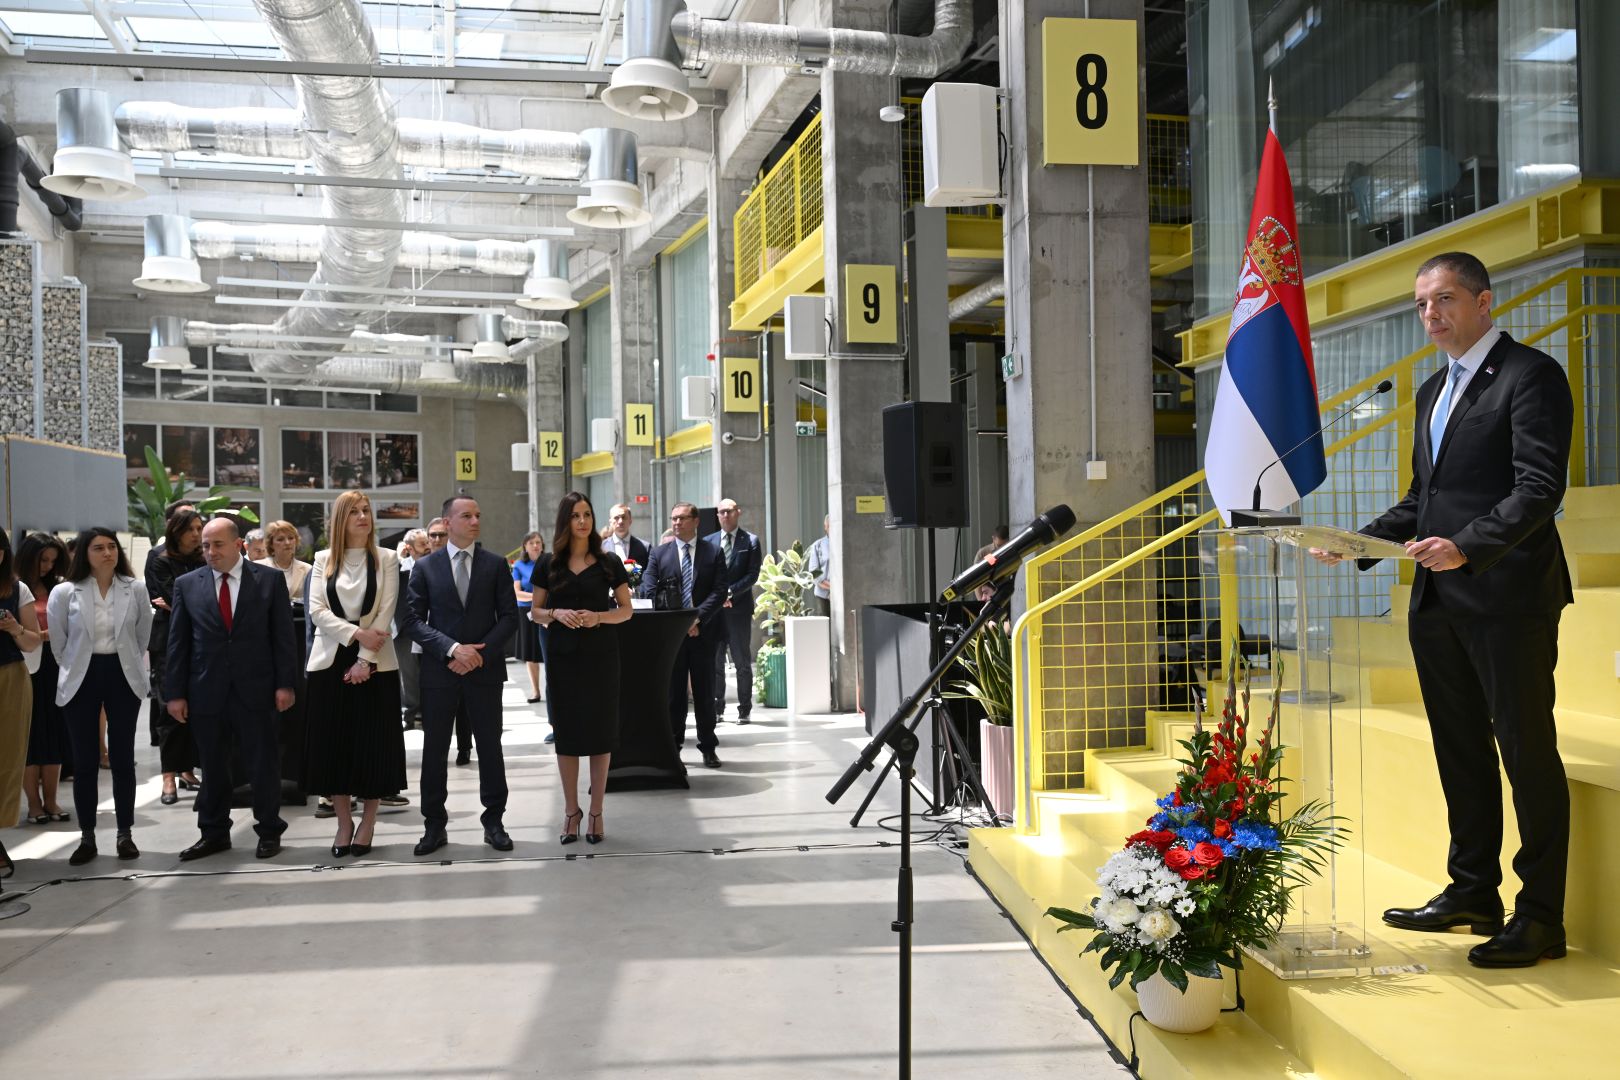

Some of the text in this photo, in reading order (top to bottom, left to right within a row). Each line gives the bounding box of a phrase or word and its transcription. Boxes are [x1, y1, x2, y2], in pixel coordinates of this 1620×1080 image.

[1076, 54, 1109, 129] 8
[862, 283, 880, 324] 9
[731, 370, 753, 399] 10
[634, 413, 646, 436] 11
[545, 439, 559, 458] 12
[460, 457, 473, 474] 13
